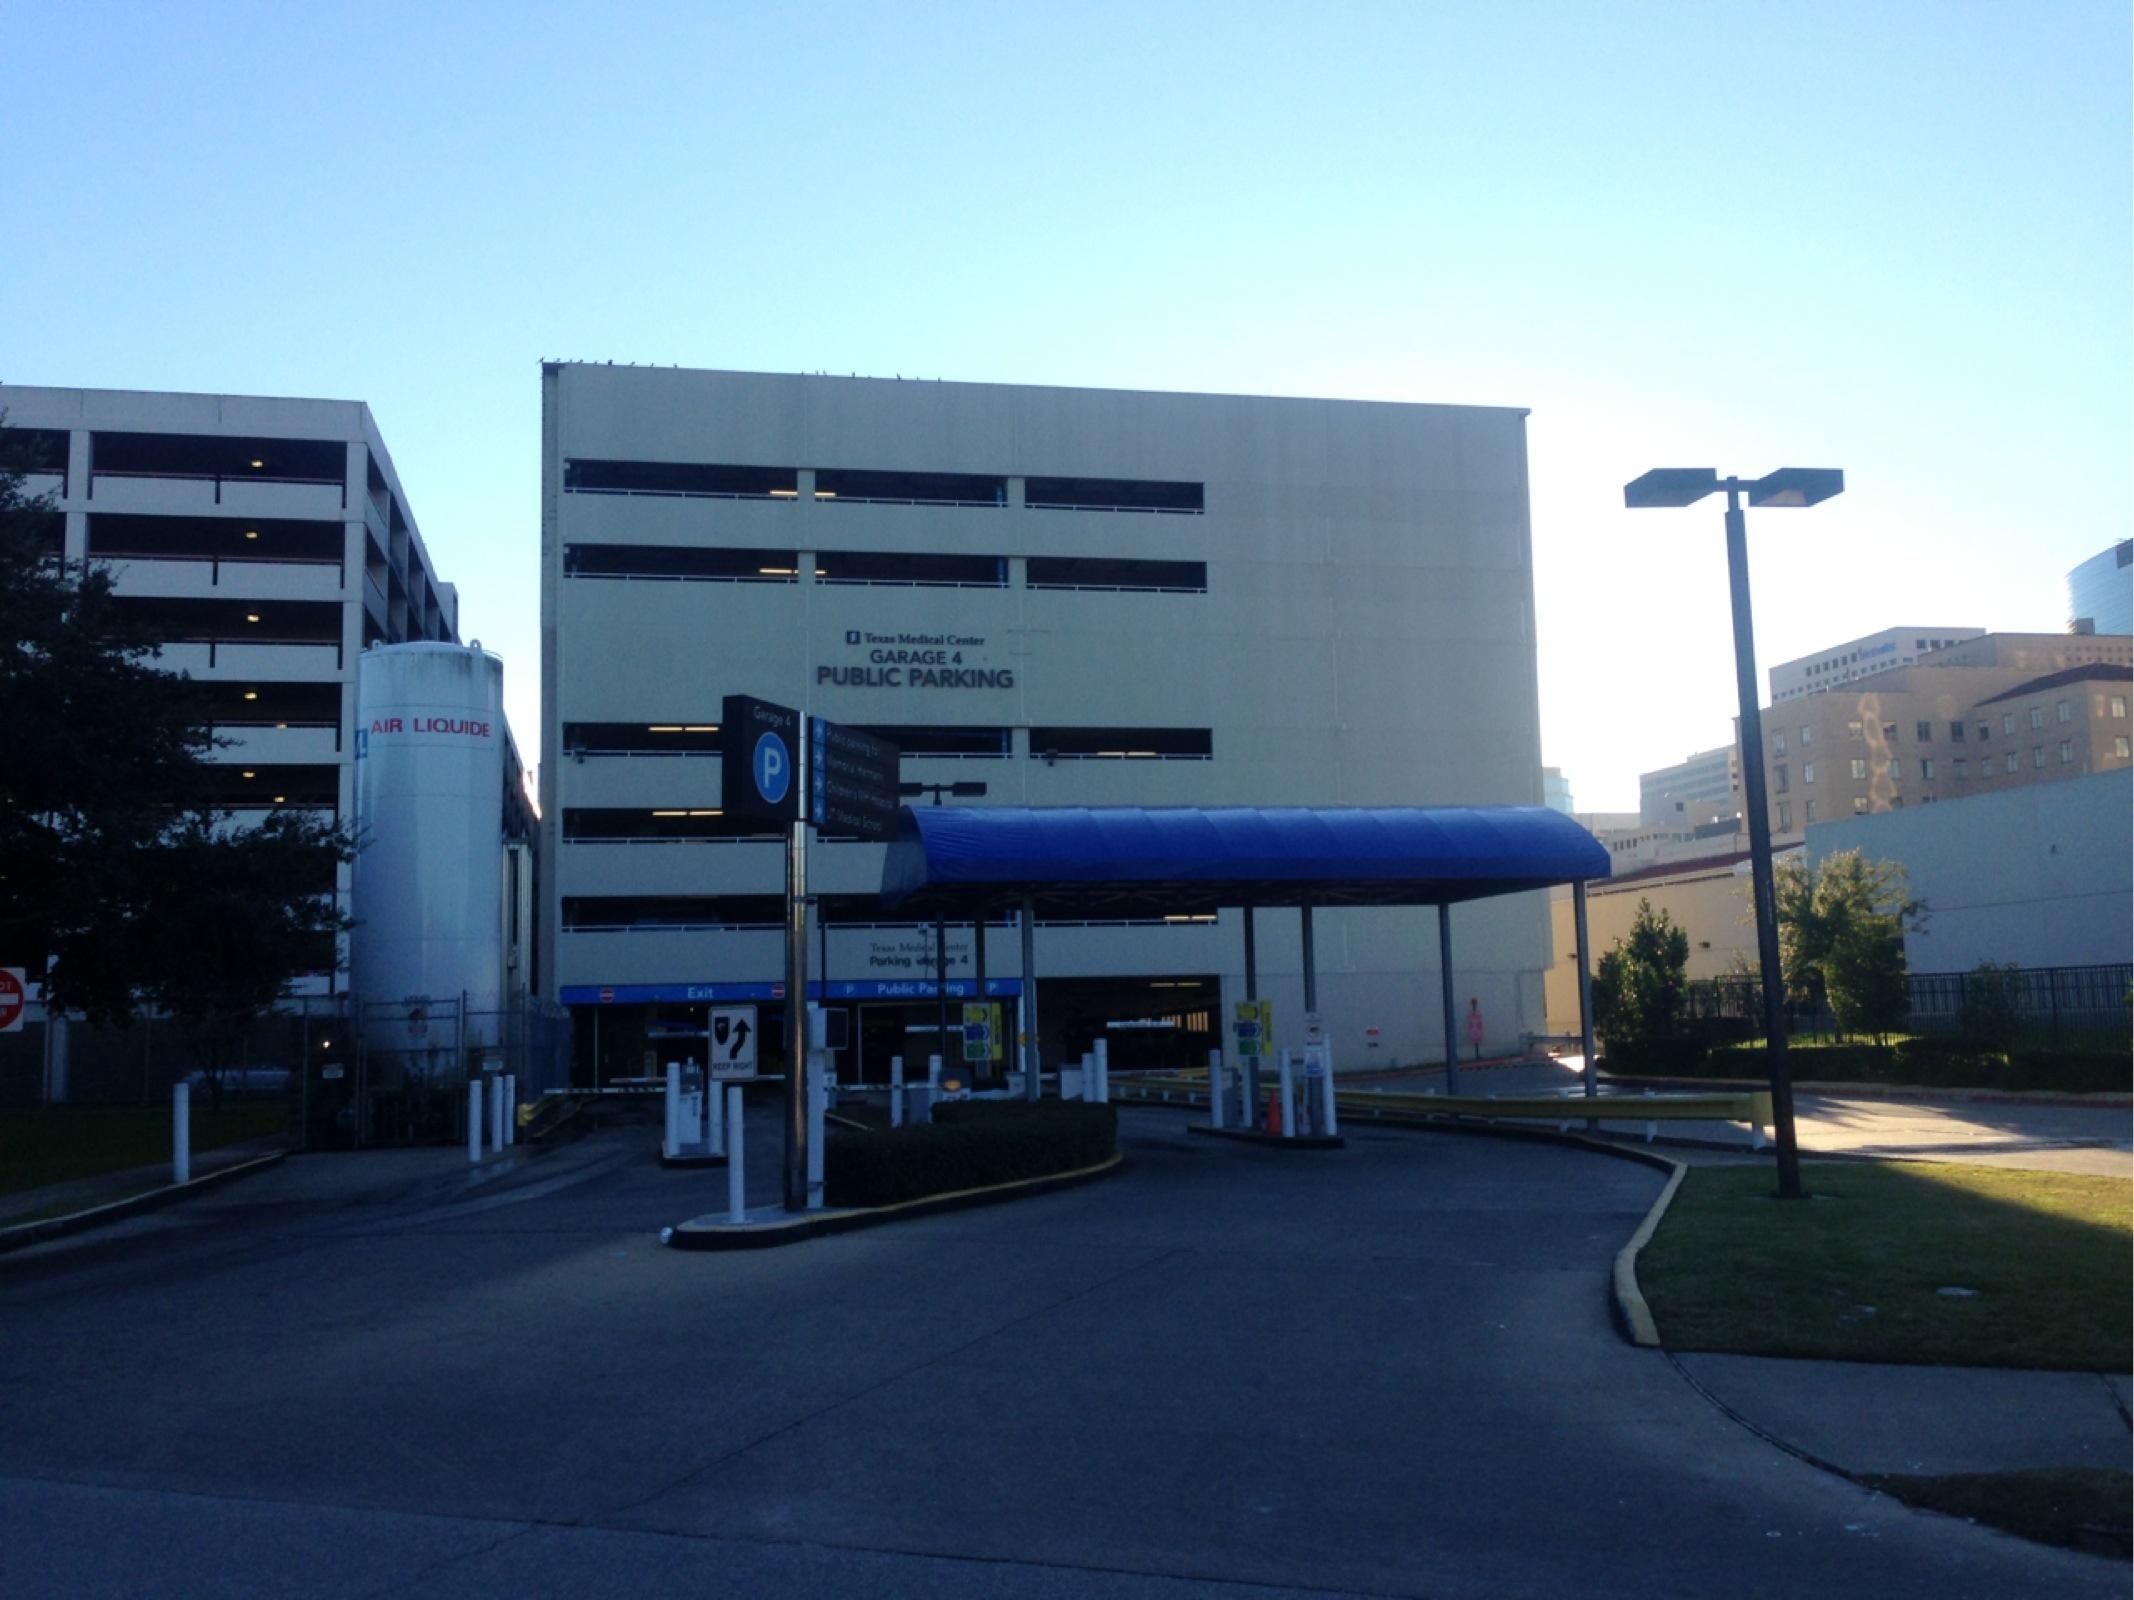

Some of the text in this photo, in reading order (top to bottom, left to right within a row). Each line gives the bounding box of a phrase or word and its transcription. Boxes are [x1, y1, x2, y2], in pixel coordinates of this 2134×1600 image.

[865, 633, 985, 646] Texas Medical Center
[870, 649, 963, 665] GARAGE 4
[817, 666, 1014, 688] PUBLIC PARKING
[371, 717, 491, 737] AIR LIQUIDE
[764, 747, 782, 788] P
[871, 943, 896, 953] Texas
[945, 945, 969, 953] enter
[869, 955, 911, 968] Parking
[960, 955, 969, 965] 4
[687, 986, 714, 1000] Exit
[877, 981, 964, 998] Public Paring
